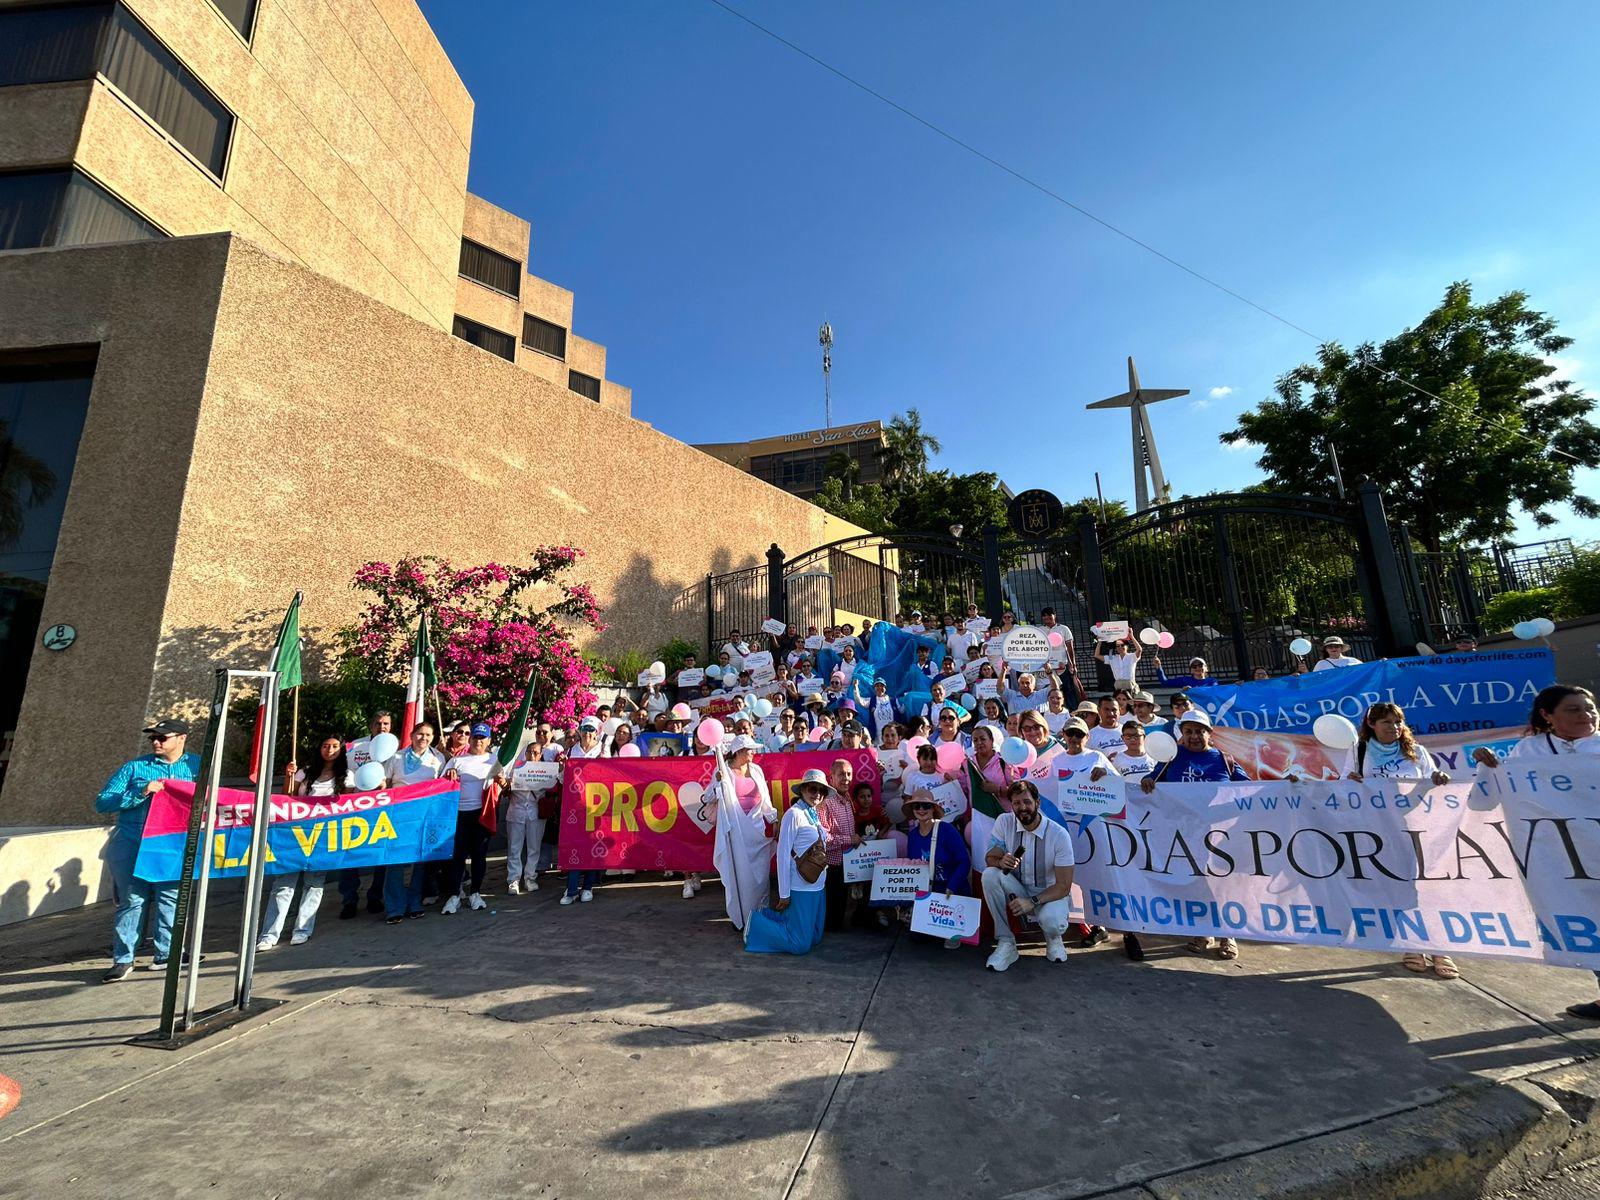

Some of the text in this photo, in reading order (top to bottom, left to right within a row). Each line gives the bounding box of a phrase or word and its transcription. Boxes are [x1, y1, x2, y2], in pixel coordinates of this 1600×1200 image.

[784, 425, 877, 445] HOTEL San Luis
[1235, 703, 1311, 731] DÍAS
[1386, 685, 1436, 710] LA
[1439, 679, 1540, 706] VIDA
[1428, 719, 1495, 734] ABORTO
[1078, 783, 1106, 792] La vida
[1079, 790, 1117, 800] SIEMPRE
[585, 780, 679, 833] PRO
[291, 810, 398, 858] VIDA
[1100, 811, 1235, 878] DÍAS
[1243, 828, 1409, 882] POR
[1402, 827, 1513, 881] LA
[177, 856, 194, 925] metrominuto
[898, 885, 920, 893] BEBÉ
[928, 906, 954, 917] Mujer
[931, 915, 955, 927] Vida
[1260, 903, 1343, 936] DEL
[1351, 907, 1430, 942] FIN
[1439, 911, 1532, 949] DEL
